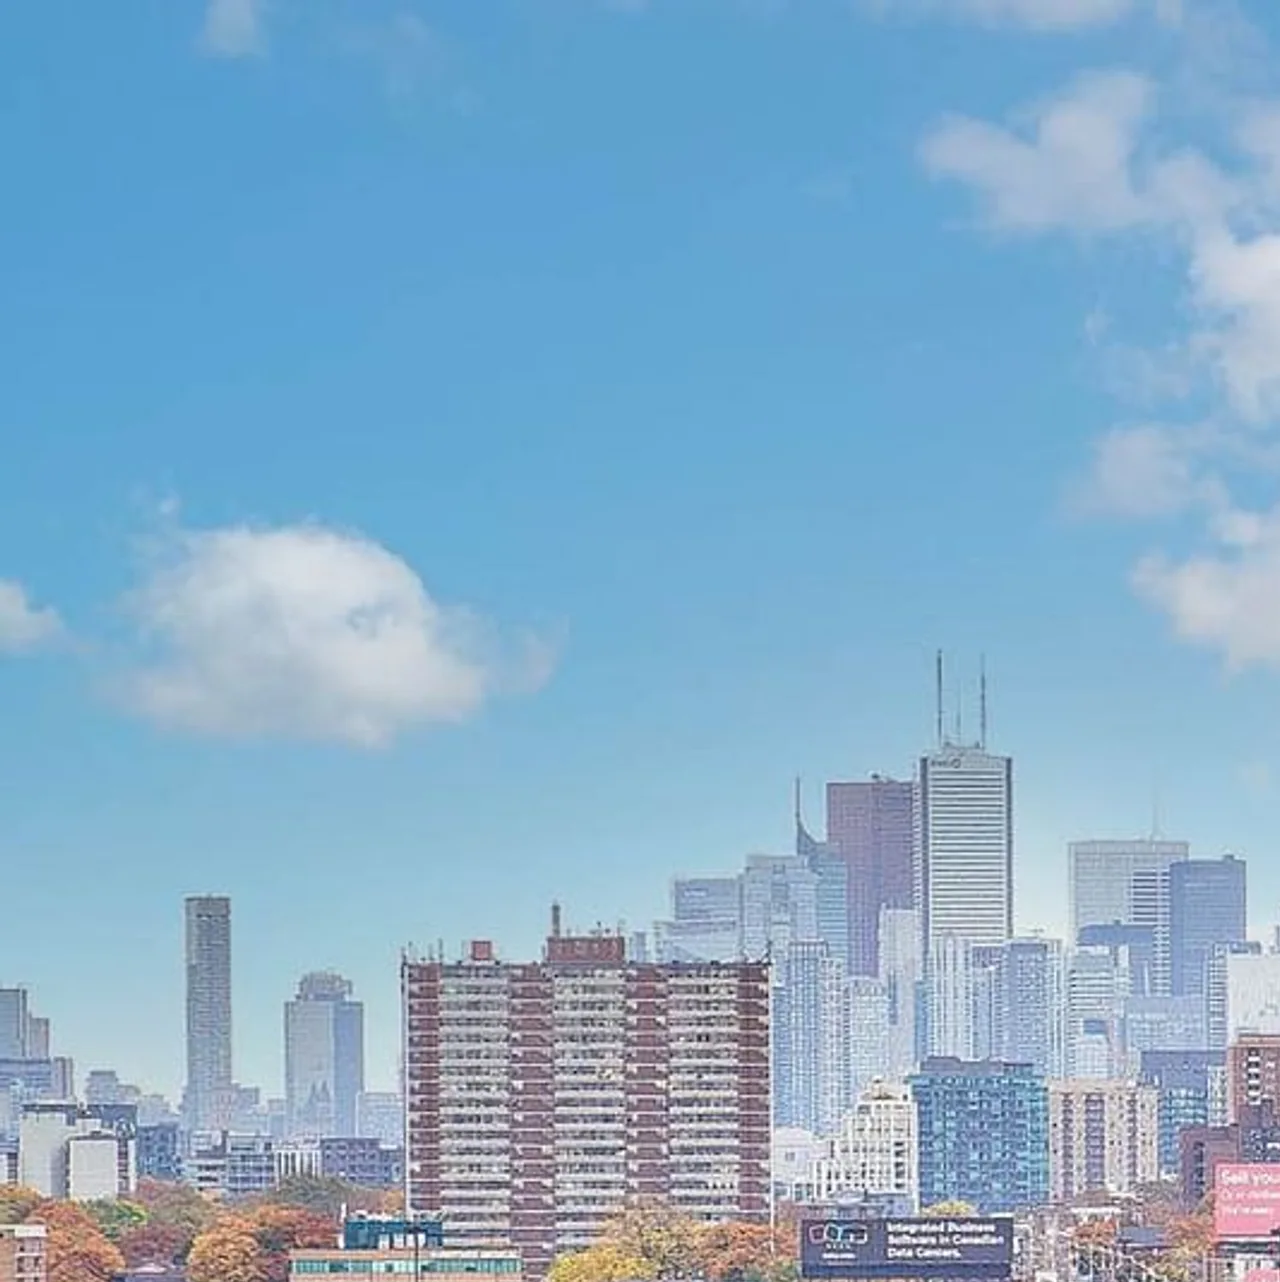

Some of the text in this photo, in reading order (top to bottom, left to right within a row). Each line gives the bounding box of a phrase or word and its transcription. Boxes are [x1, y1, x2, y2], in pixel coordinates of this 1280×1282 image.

[1221, 1169, 1249, 1186] Sell
[887, 1221, 996, 1237] Integrated Business
[887, 1233, 1005, 1245] Software in Canadian
[887, 1246, 913, 1258] Data
